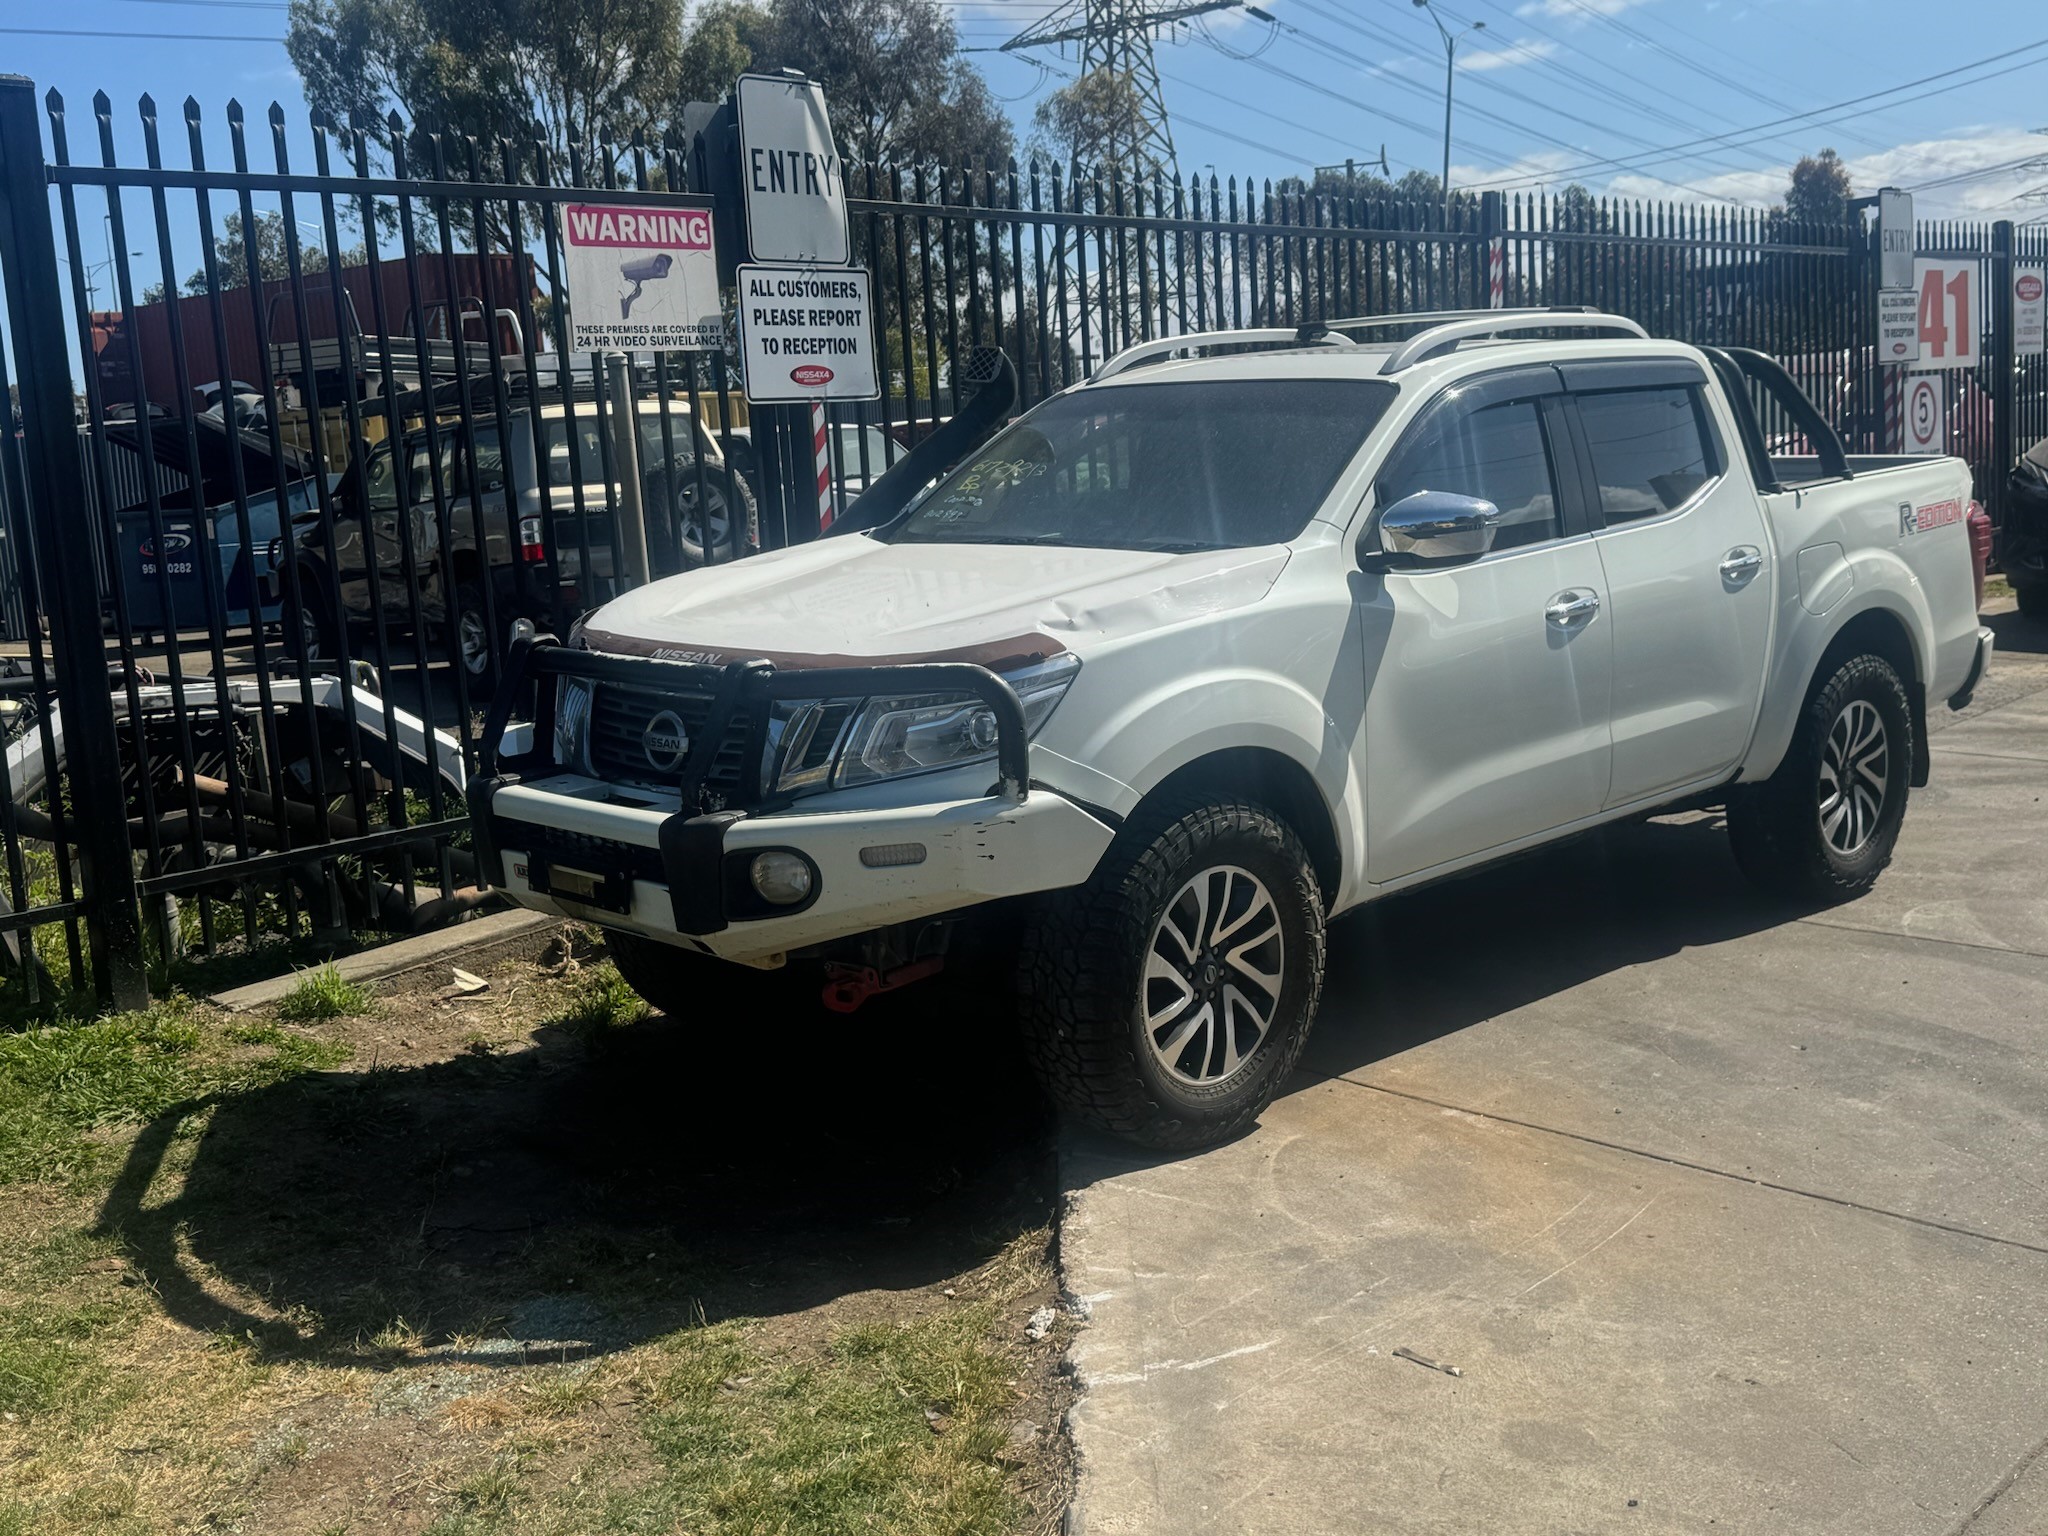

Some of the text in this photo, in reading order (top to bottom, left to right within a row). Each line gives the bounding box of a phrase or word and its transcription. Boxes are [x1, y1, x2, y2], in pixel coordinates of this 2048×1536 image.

[751, 148, 835, 197] ENTRY
[570, 210, 709, 246] WARNING
[1884, 229, 1911, 253] ENTRY
[750, 279, 862, 303] ALL CUSTOMERS,
[754, 309, 862, 327] PLEASE REPORT
[1920, 269, 1969, 358] 41
[576, 325, 720, 334] THESE PREMISES ARE COVERED BY
[577, 335, 722, 347] 24 HR VIDEO SURVEILANCE
[761, 337, 858, 355] TO RECEPTION
[1919, 392, 1928, 424] 5
[650, 648, 723, 665] NISSAN
